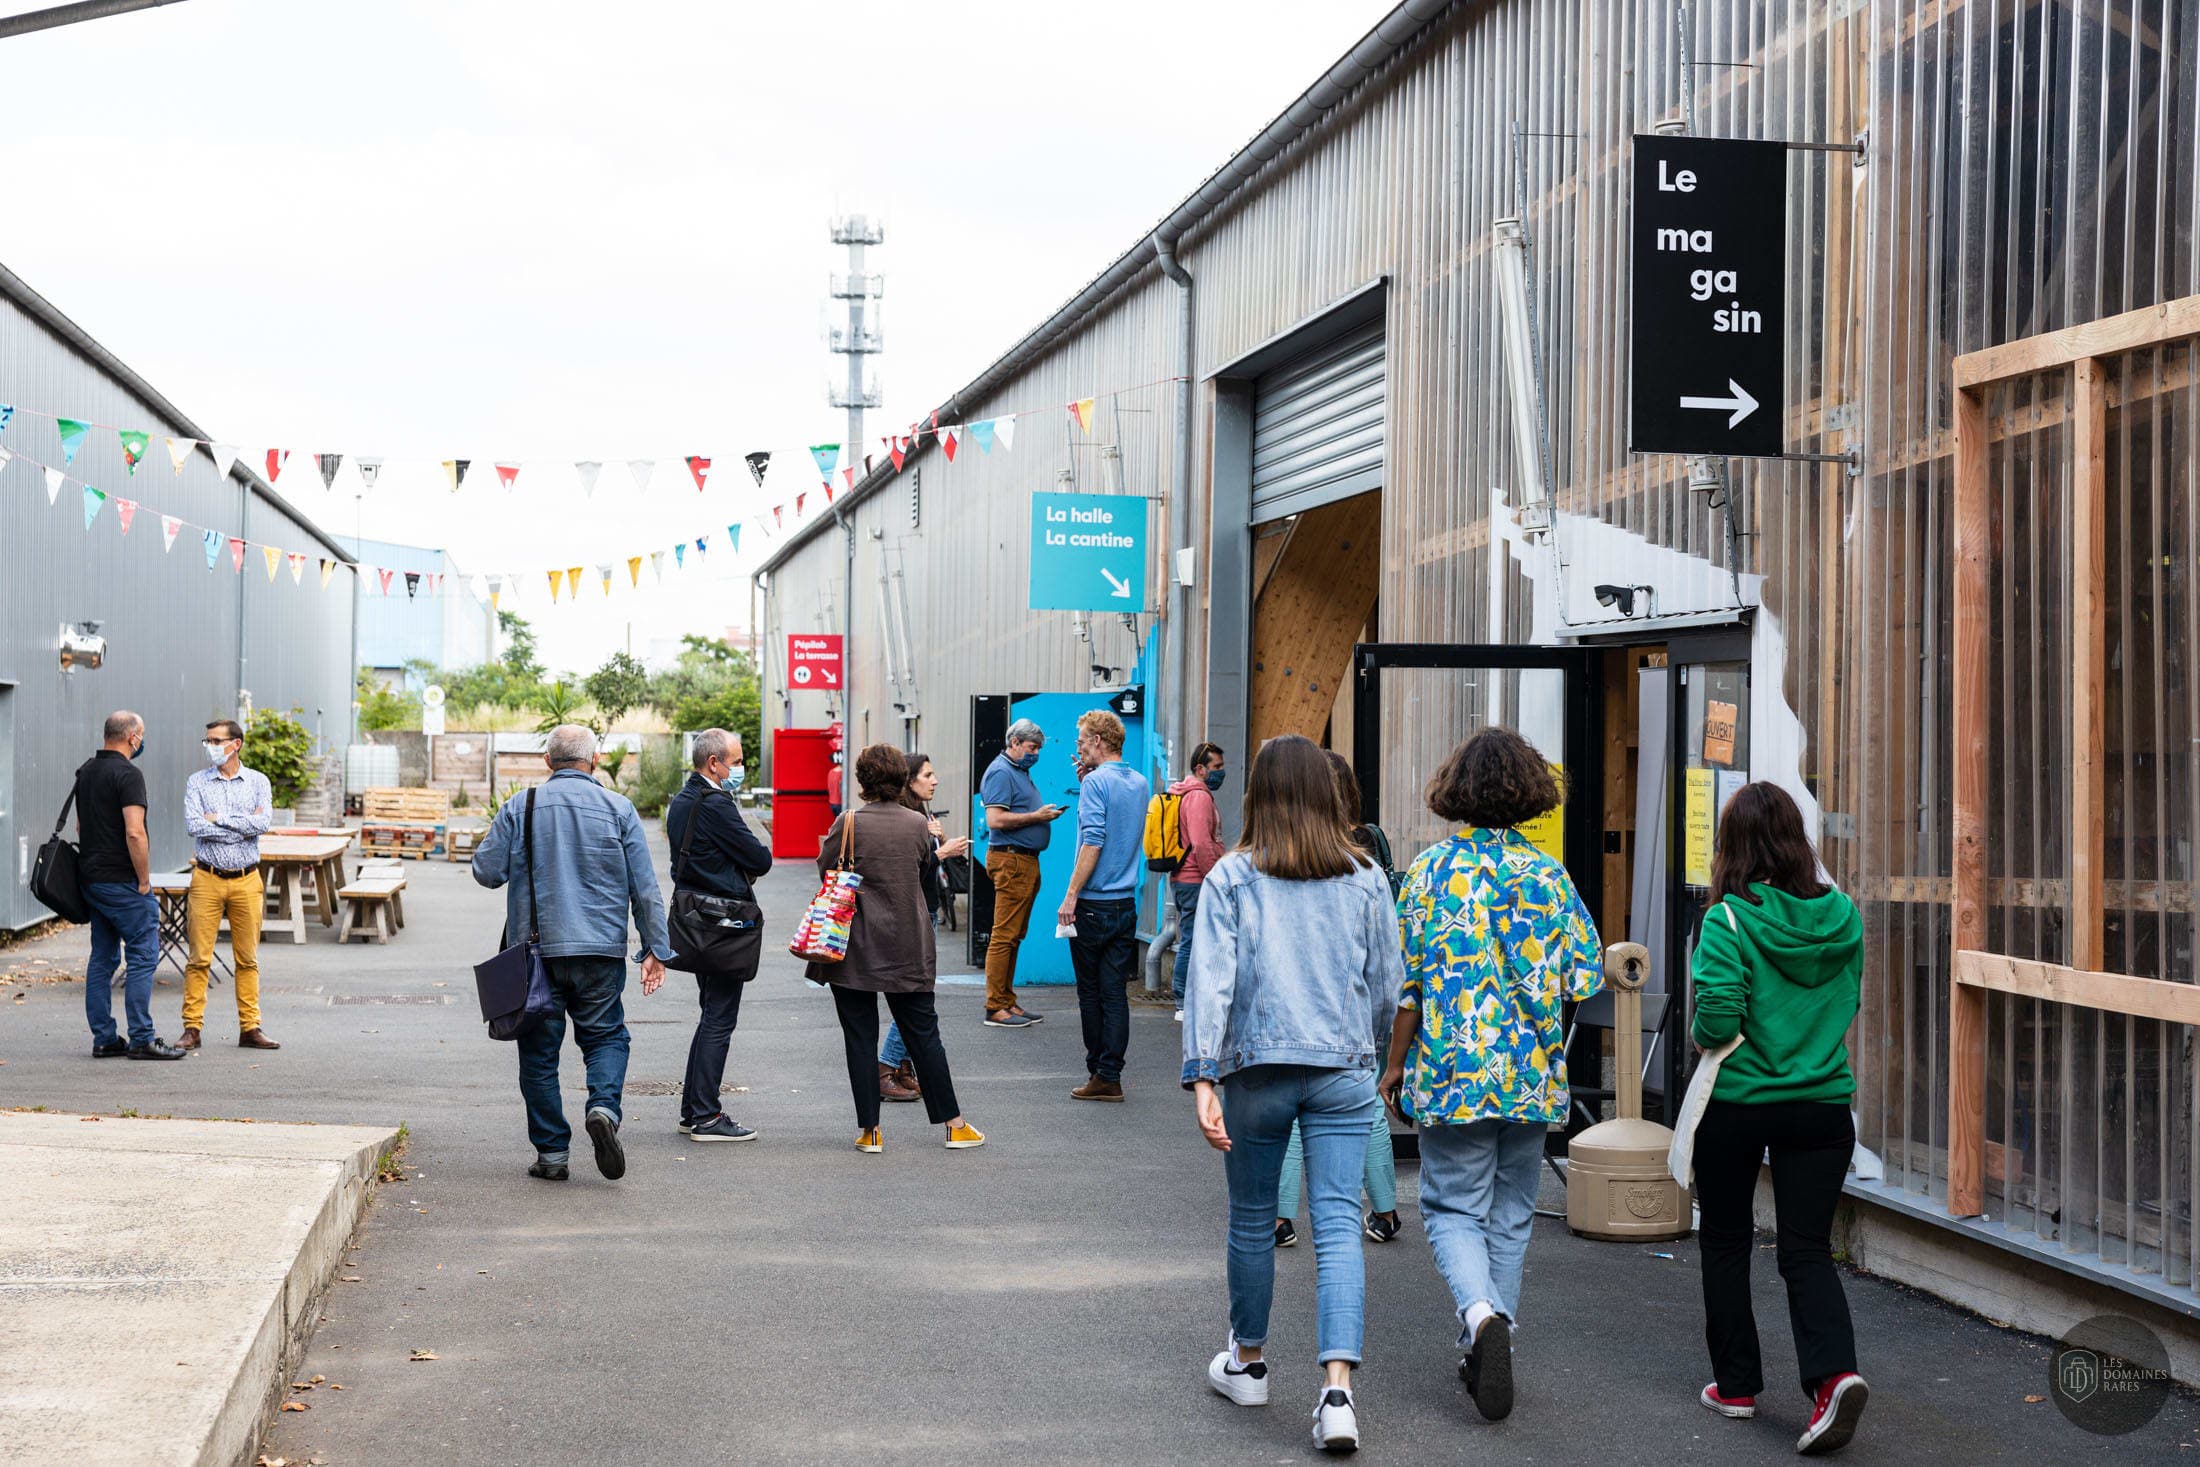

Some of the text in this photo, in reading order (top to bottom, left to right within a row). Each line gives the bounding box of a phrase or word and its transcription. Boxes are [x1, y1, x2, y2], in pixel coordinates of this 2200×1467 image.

[1658, 160, 1697, 193] Le
[1657, 228, 1712, 252] ma
[1690, 269, 1737, 301] ga
[1713, 301, 1761, 333] sin
[1046, 506, 1113, 524] La halle
[1046, 529, 1134, 548] La cantine
[794, 651, 839, 660] La terrasse
[1706, 720, 1734, 738] OUVERT
